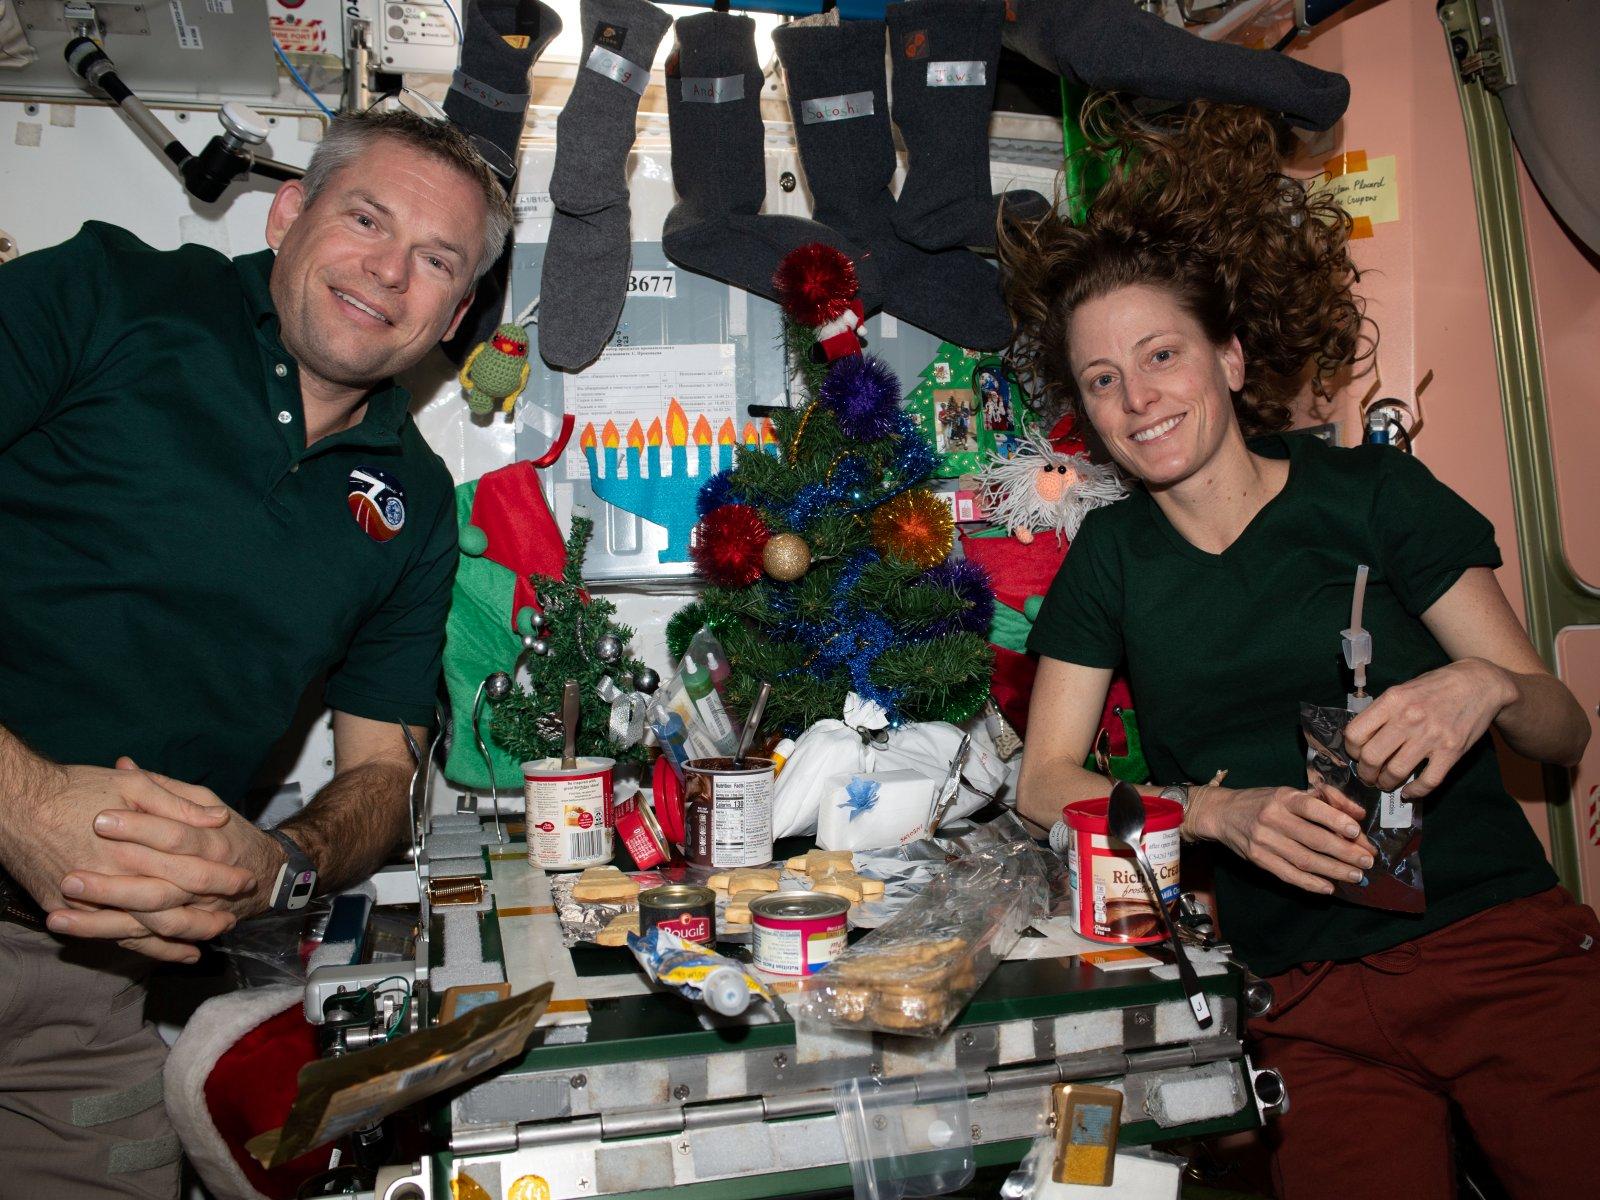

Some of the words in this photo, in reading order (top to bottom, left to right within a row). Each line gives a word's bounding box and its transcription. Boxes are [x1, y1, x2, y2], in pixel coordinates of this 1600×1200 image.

[693, 83, 724, 99] Andy
[806, 101, 861, 119] Satoshi
[1112, 870, 1146, 884] Rich
